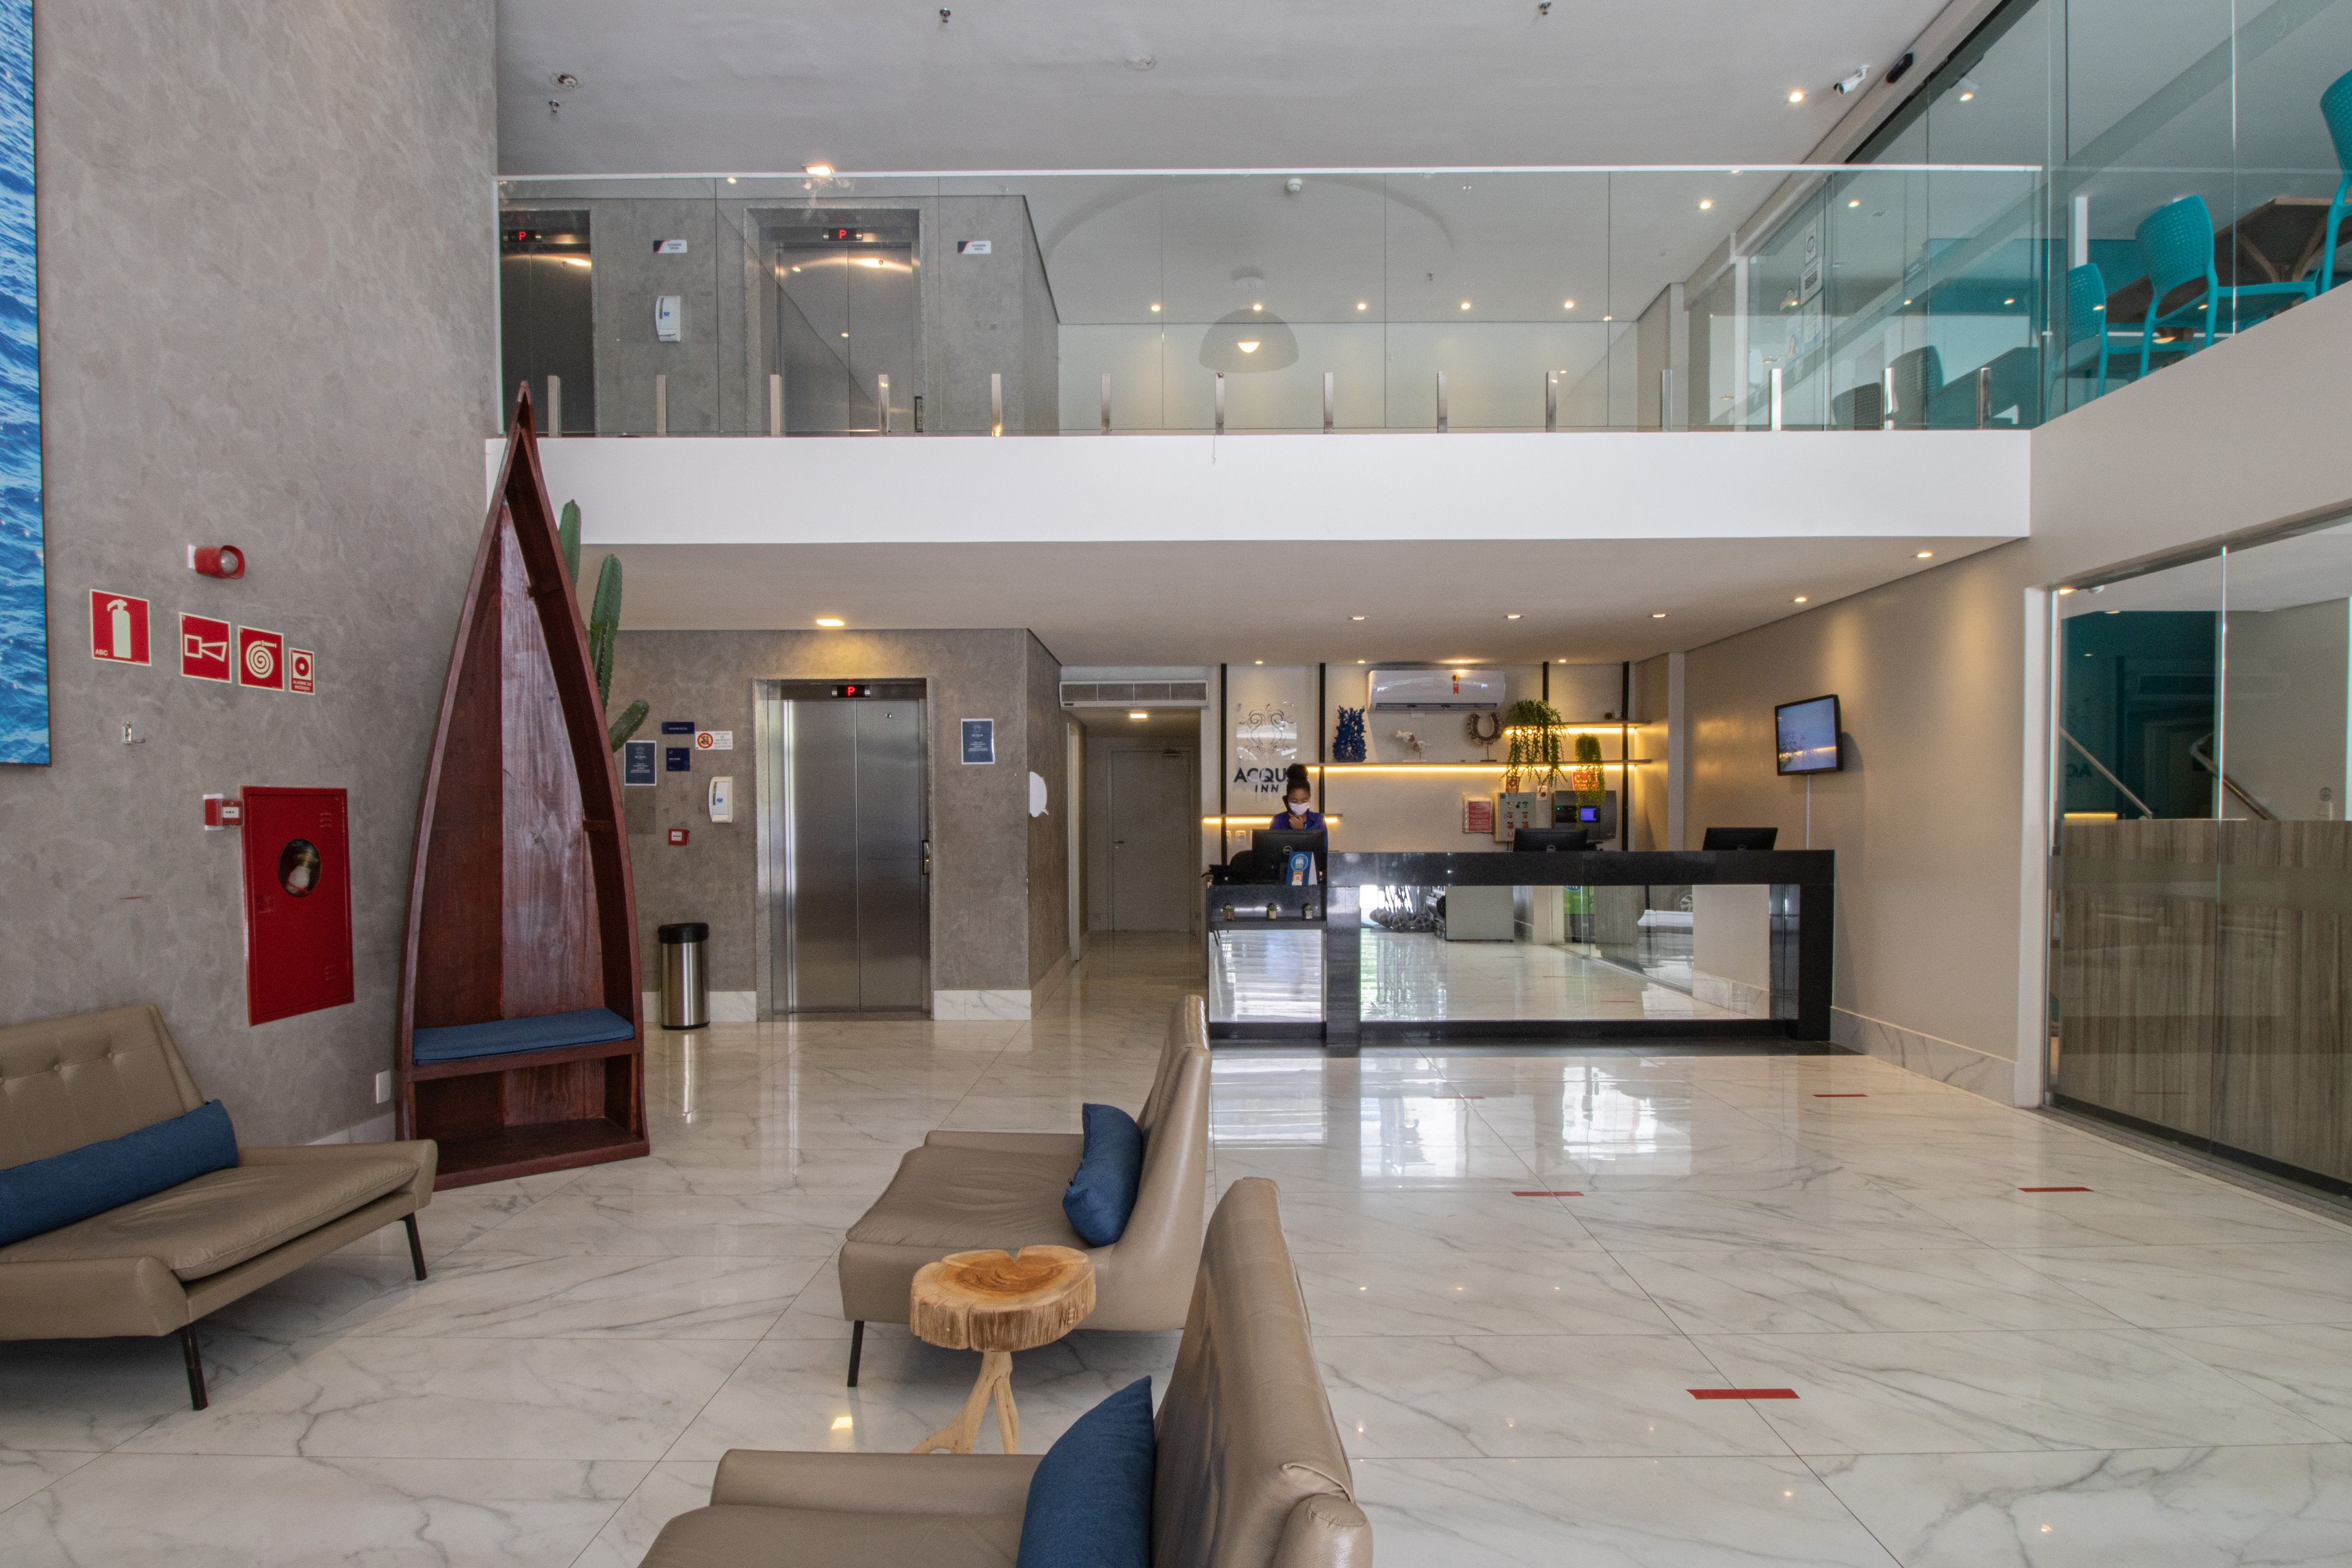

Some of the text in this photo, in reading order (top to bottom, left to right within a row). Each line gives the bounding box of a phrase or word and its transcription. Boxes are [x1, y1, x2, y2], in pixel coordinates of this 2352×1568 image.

[519, 230, 526, 241] P
[839, 228, 846, 239] P
[848, 687, 855, 696] P
[1234, 767, 1288, 783] ACQU
[1255, 785, 1279, 793] INN
